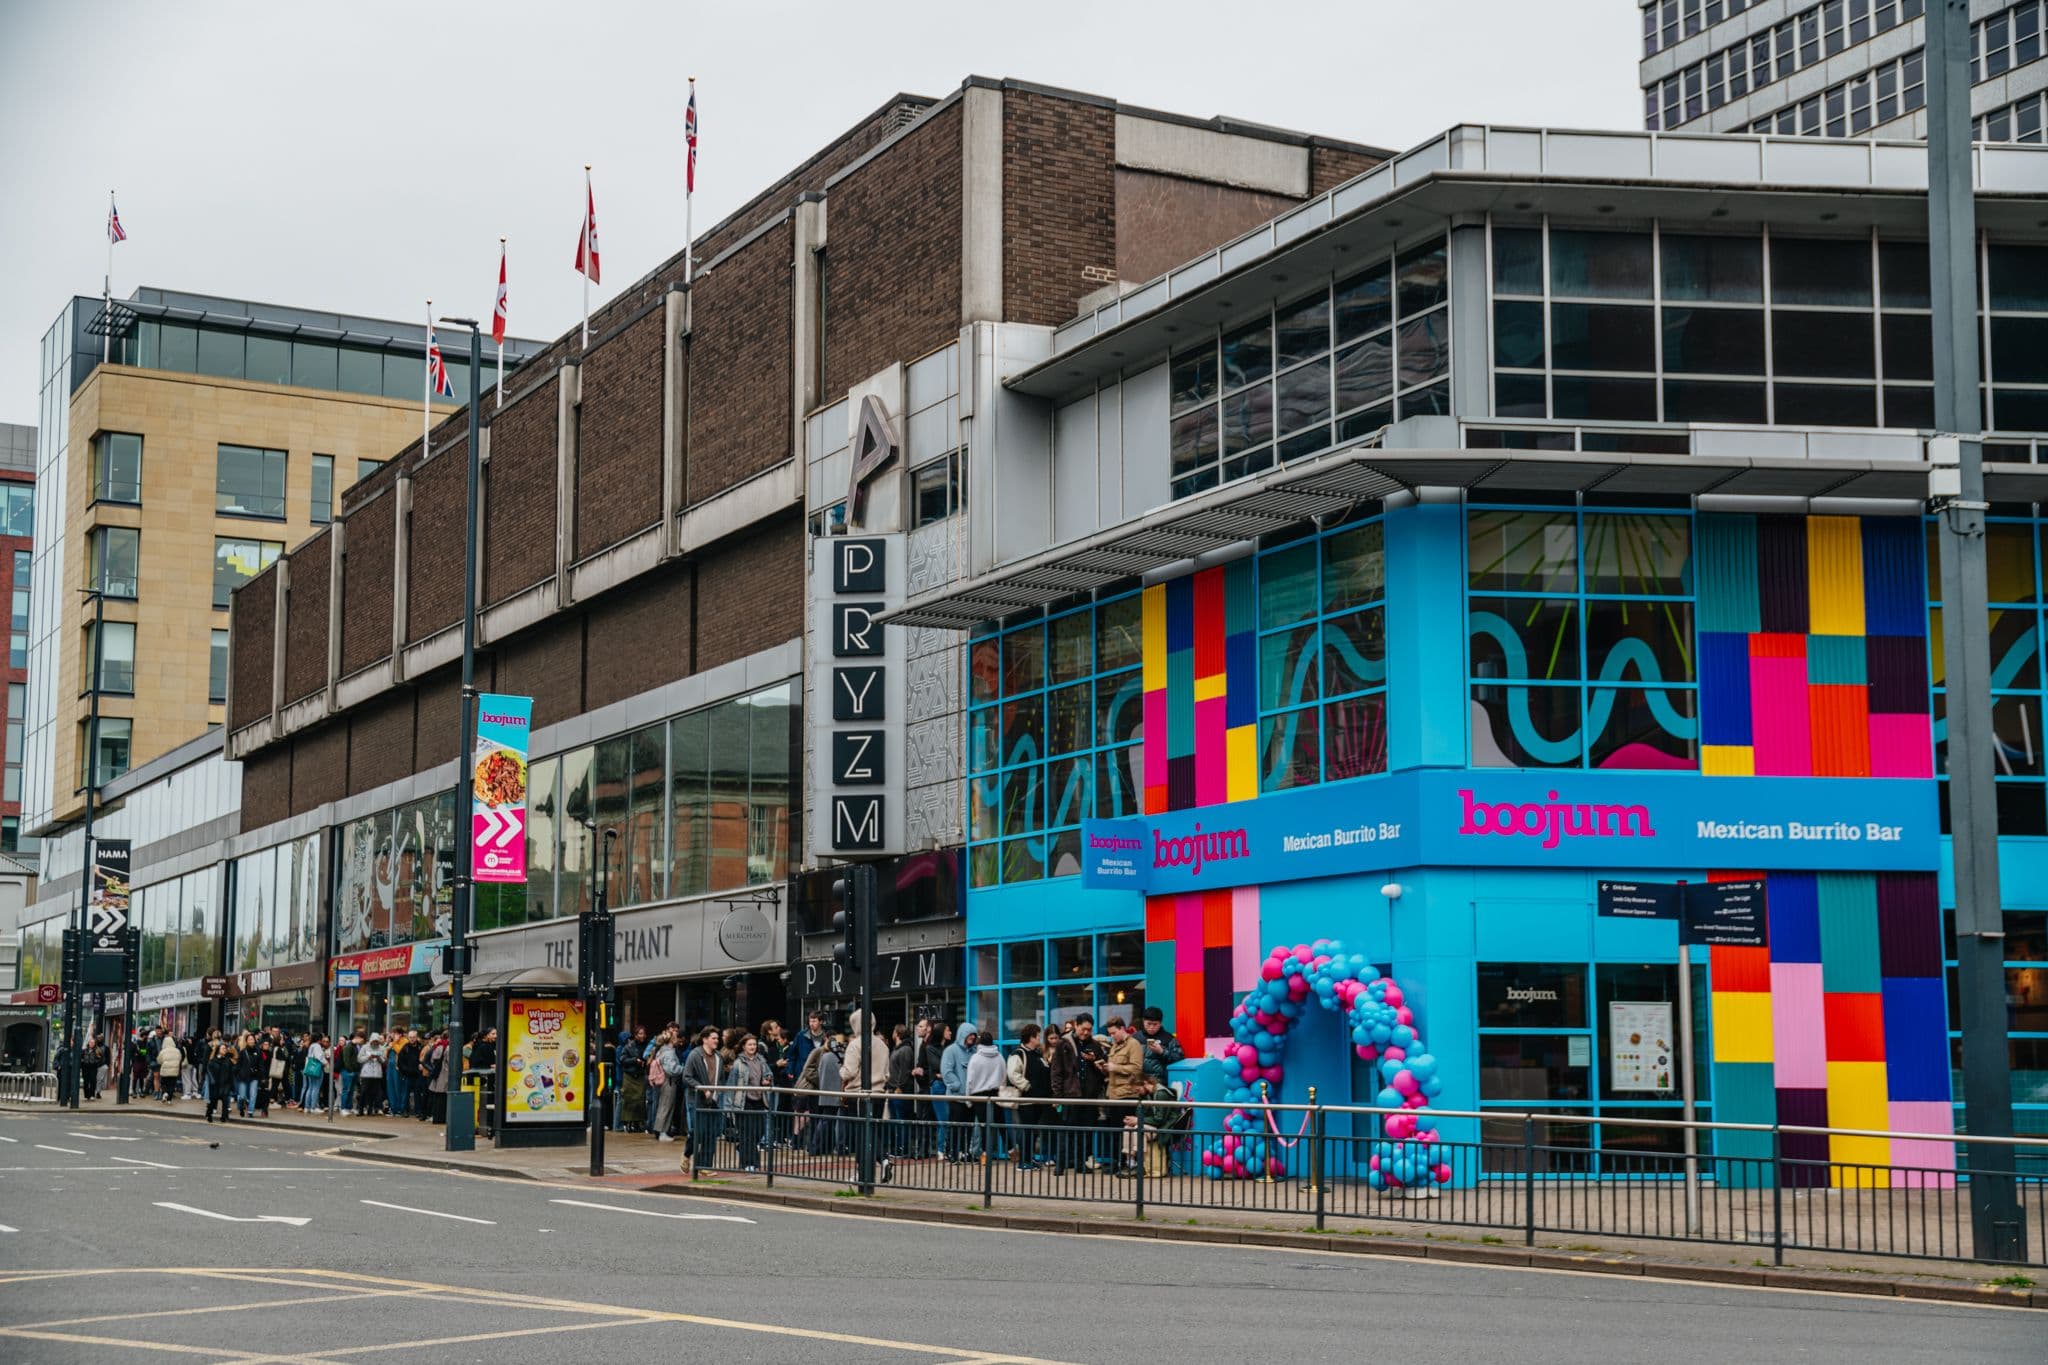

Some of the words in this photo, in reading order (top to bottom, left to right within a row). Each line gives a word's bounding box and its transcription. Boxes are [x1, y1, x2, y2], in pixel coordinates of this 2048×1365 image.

[836, 544, 879, 843] PRYZM
[482, 711, 527, 727] boojum
[1458, 788, 1656, 849] boojum
[1283, 832, 1332, 853] Mexican
[1334, 825, 1377, 846] Burrito
[1379, 822, 1401, 840] Bar
[1697, 820, 1784, 840] Mexican
[1789, 821, 1861, 841] Burrito
[1865, 823, 1903, 842] Bar
[1090, 833, 1143, 853] boojum
[1153, 822, 1250, 876] boojum
[98, 850, 128, 859] HAMA
[1102, 858, 1133, 867] Mexican
[1097, 867, 1123, 876] Burrito
[1124, 867, 1137, 876] Bar
[726, 932, 767, 940] MERCHANT
[740, 924, 753, 932] THE
[545, 938, 574, 969] THE
[614, 924, 673, 964] CHANT
[806, 952, 936, 995] PRZM
[1507, 986, 1557, 1003] boojum
[528, 1009, 565, 1020] Winning
